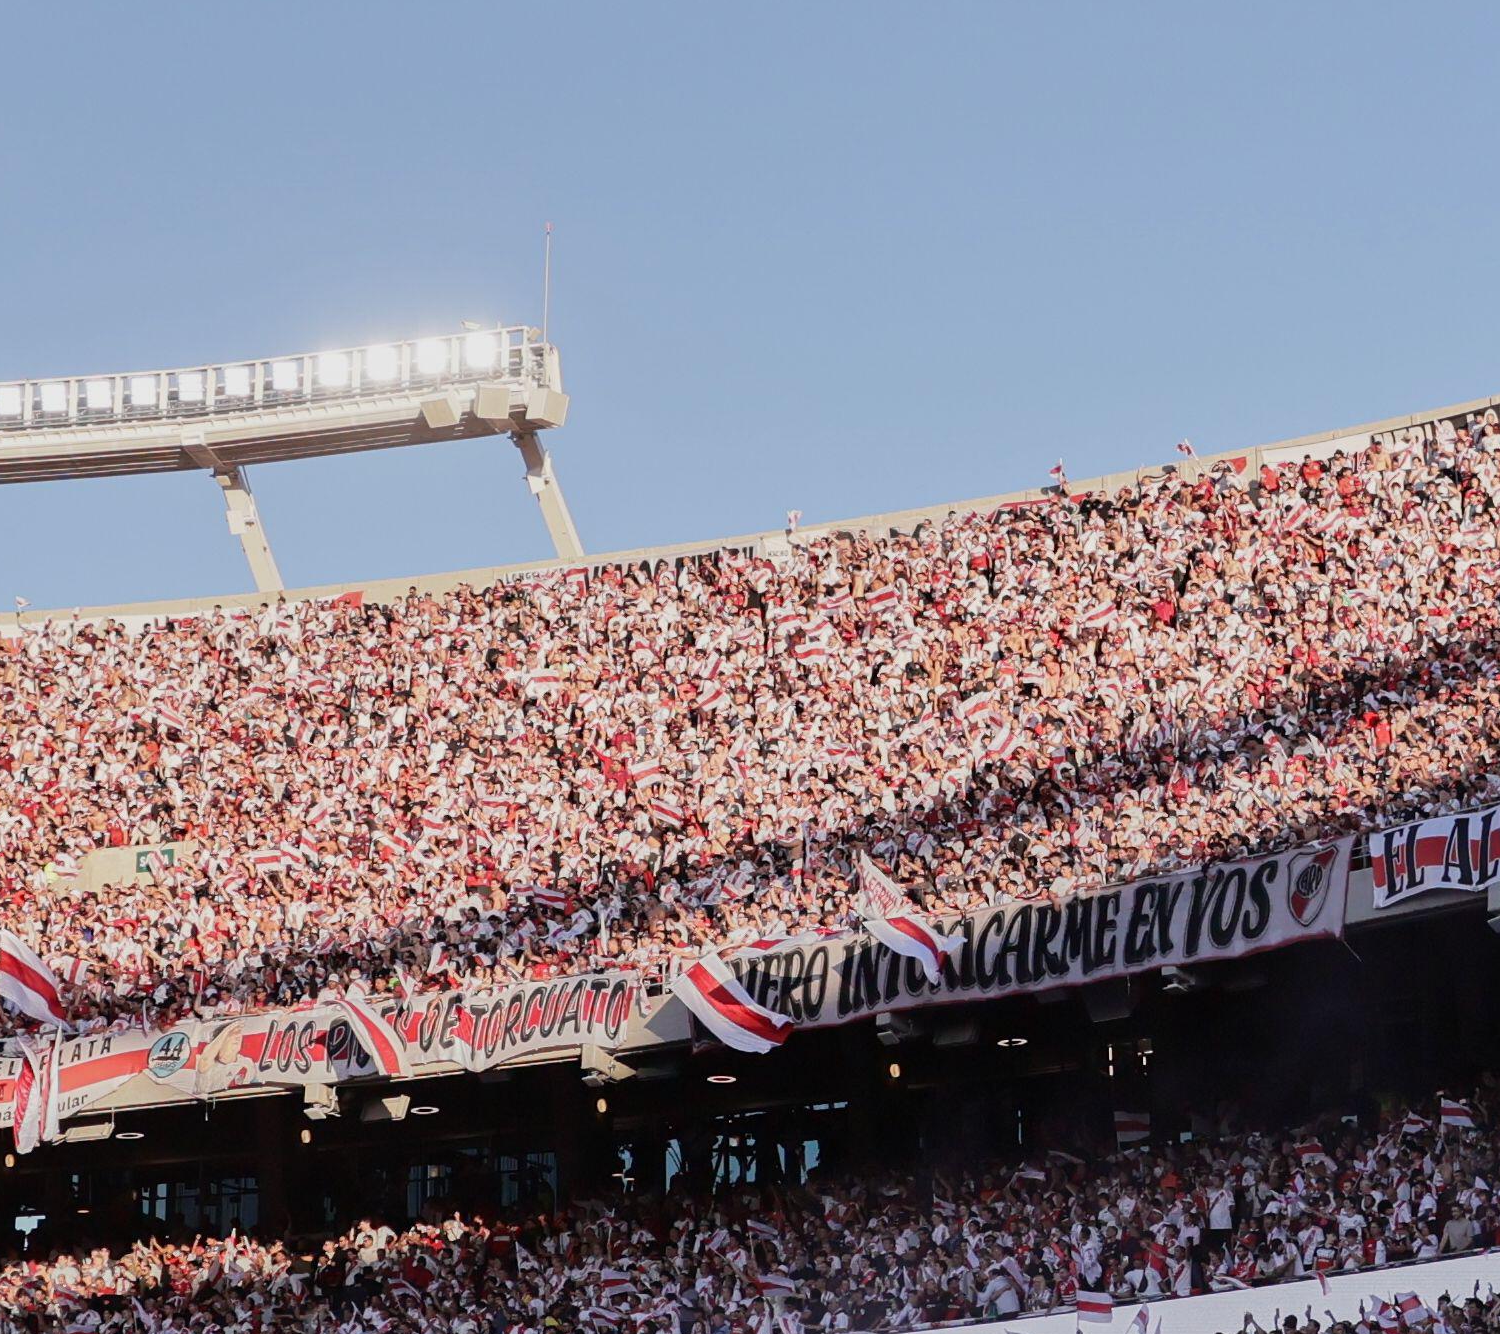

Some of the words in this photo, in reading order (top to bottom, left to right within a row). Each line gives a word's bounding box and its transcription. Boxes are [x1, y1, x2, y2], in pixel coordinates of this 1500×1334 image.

[1385, 824, 1424, 899] EL
[1124, 873, 1181, 965] EN
[1184, 859, 1279, 956] VOS
[259, 1018, 315, 1073] LOS
[420, 994, 459, 1052] DE
[471, 978, 627, 1060] TORCUATO
